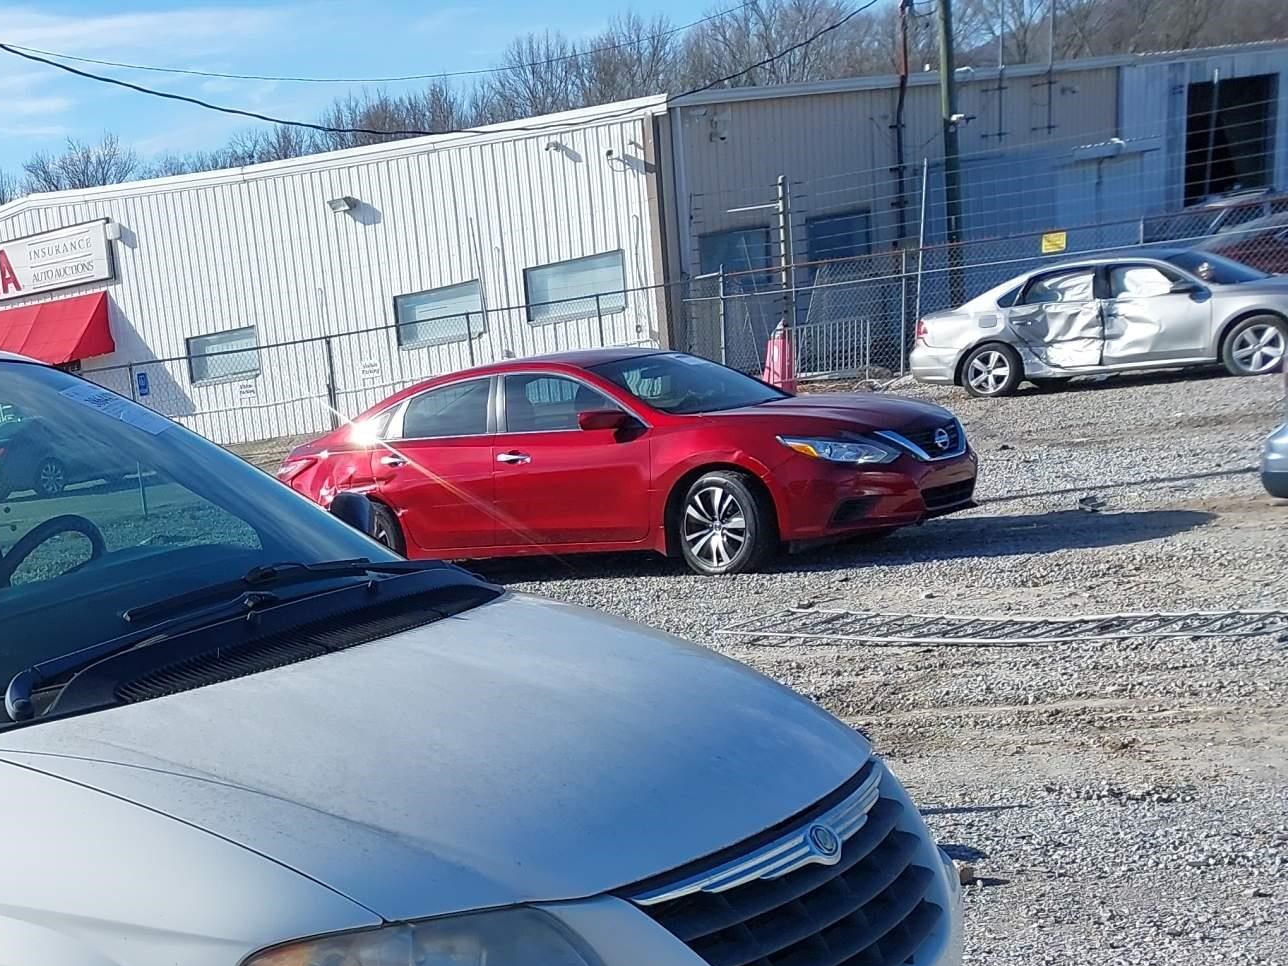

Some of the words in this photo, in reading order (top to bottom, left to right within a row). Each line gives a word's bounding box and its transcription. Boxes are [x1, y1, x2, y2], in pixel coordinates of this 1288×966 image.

[29, 237, 92, 261] INSURANCE
[32, 268, 55, 283] AUTO
[54, 261, 95, 280] AUCTIONS
